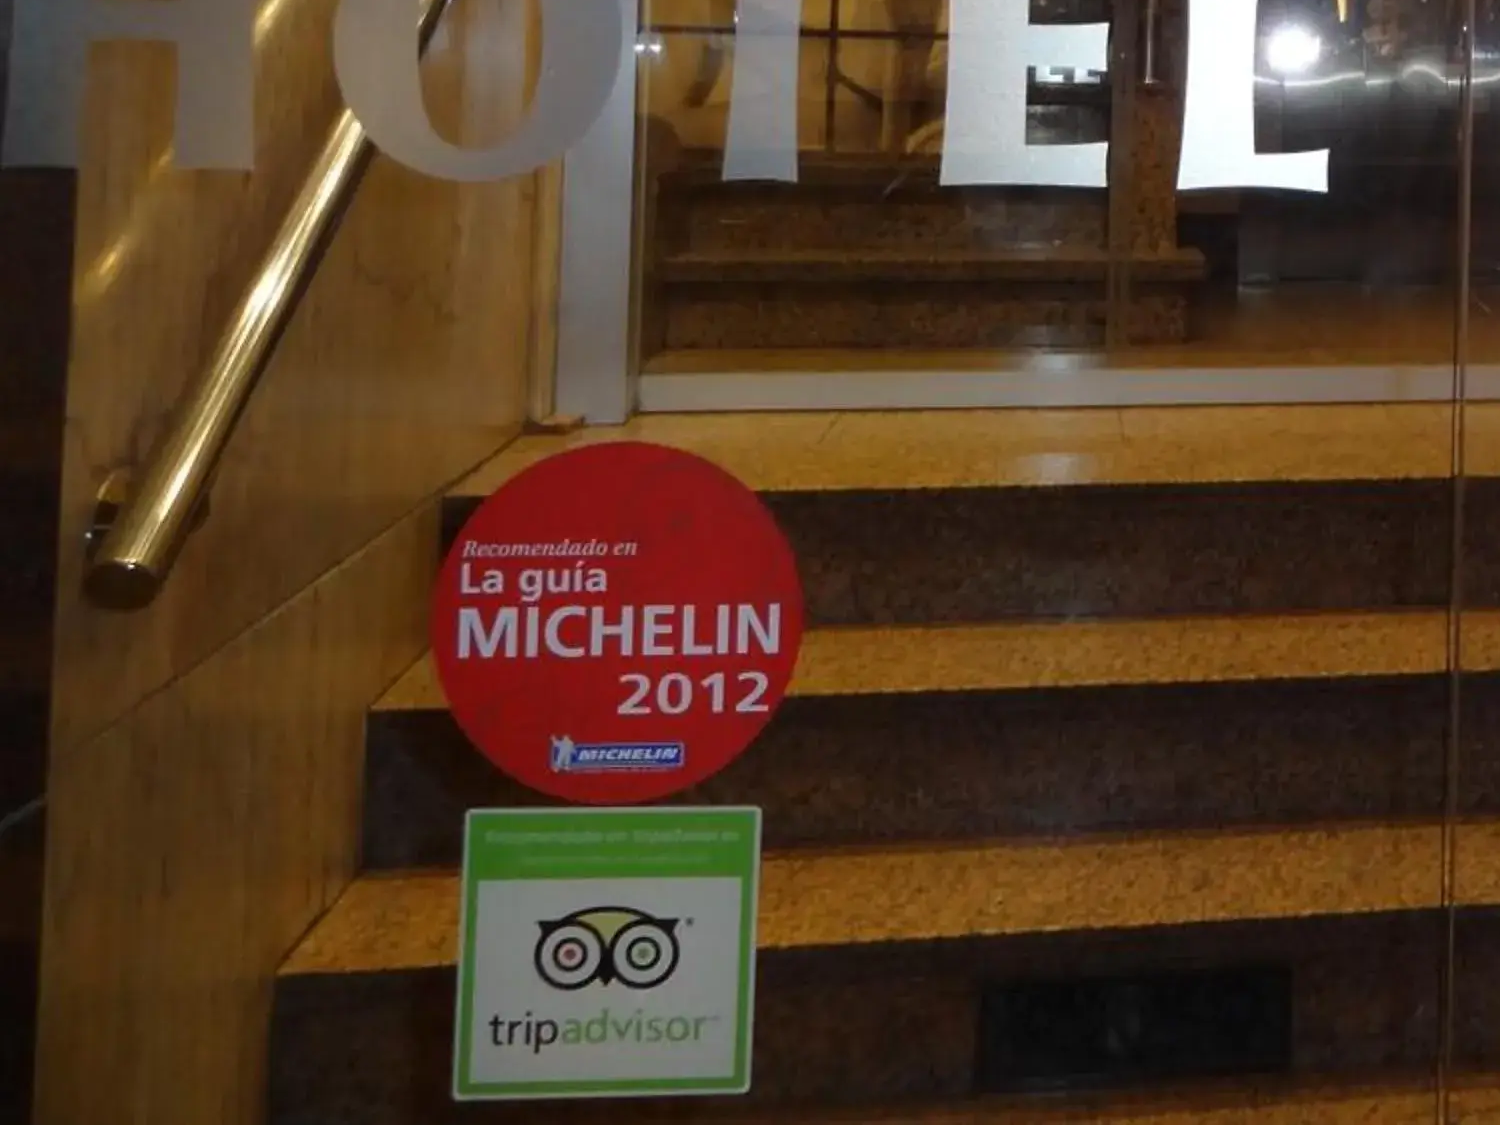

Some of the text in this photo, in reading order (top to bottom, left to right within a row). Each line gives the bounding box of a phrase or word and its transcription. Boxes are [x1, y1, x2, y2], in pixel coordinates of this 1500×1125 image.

[462, 540, 638, 558] Recomendado en
[460, 561, 609, 603] La guía
[456, 602, 782, 660] MICHELIN
[616, 671, 770, 716] 2012
[578, 747, 679, 761] MICHELIN
[488, 1008, 709, 1054] tripadvisor
